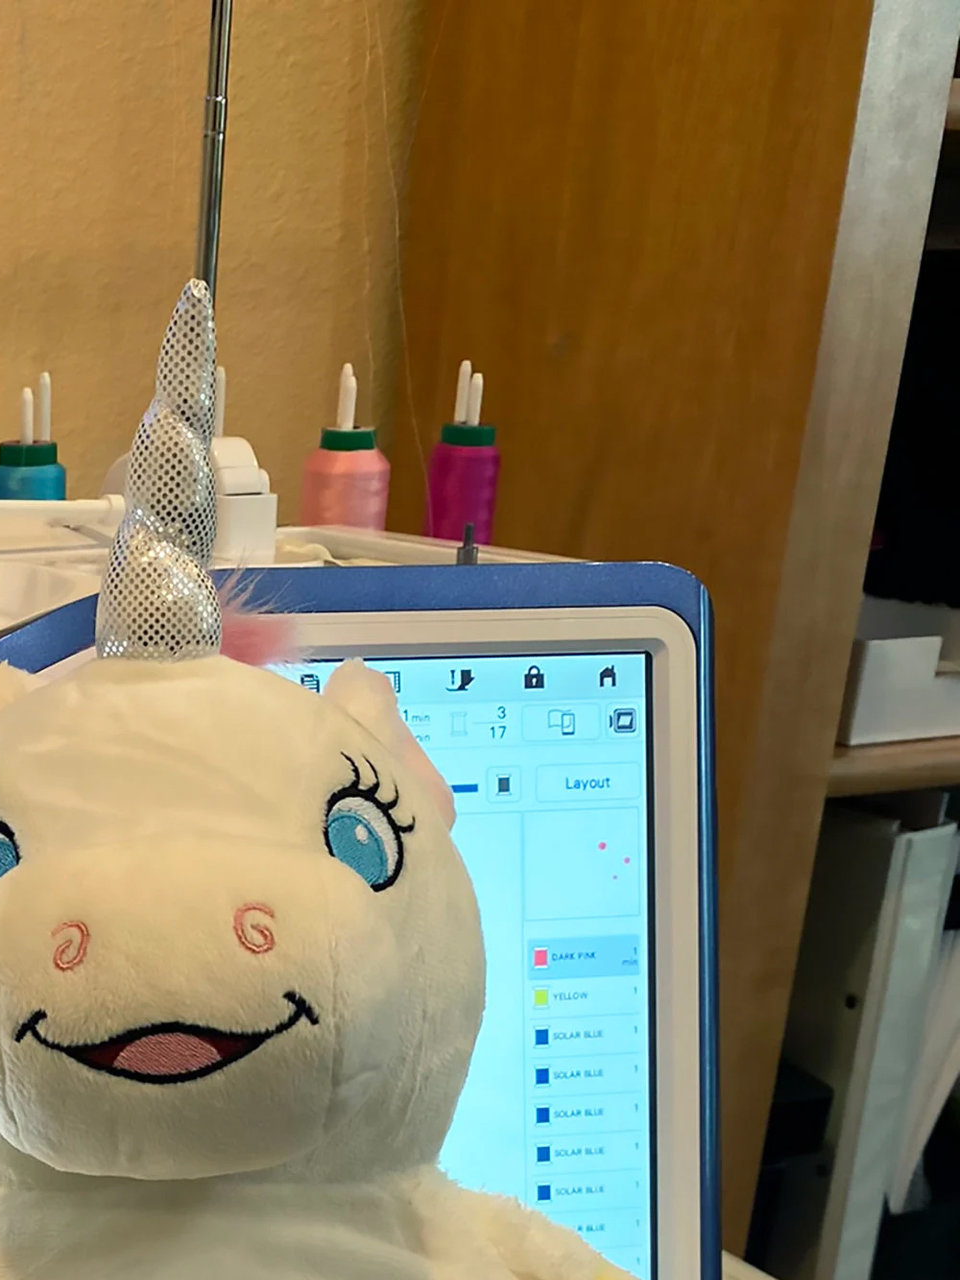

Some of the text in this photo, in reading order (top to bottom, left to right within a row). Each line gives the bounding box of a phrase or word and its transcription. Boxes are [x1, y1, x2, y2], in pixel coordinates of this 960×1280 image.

[497, 705, 507, 720] 3
[490, 725, 507, 739] 17
[565, 776, 610, 791] Layout
[551, 951, 596, 961] DARK PINK
[553, 991, 588, 1001] YELLOW
[553, 1030, 603, 1040] SOLAR BLUE
[553, 1069, 604, 1080] SOLAR BLUE
[554, 1108, 604, 1118] SOLAR BLUE
[554, 1147, 605, 1157] SOLAR BLUE
[555, 1186, 604, 1196] SOLAR BLUE
